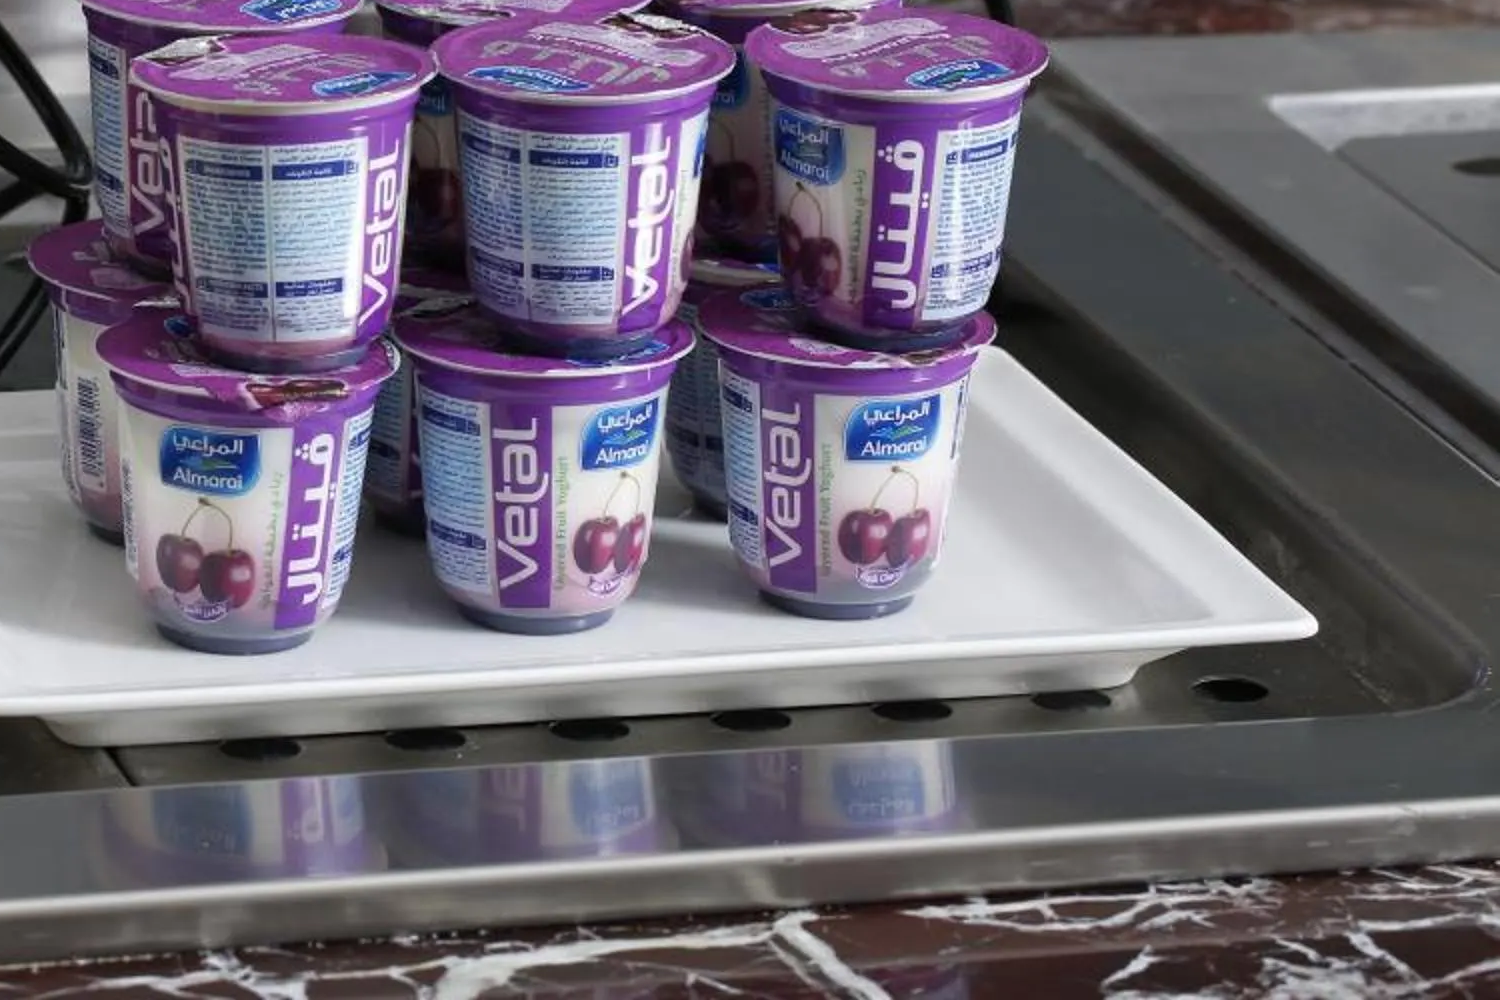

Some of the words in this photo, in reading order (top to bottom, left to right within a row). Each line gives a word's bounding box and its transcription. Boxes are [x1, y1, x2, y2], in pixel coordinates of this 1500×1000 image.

[129, 91, 167, 238] Veta
[780, 149, 831, 181] Almarai
[596, 403, 652, 433] المراعي
[863, 401, 930, 426] المراعي
[172, 432, 244, 457] المراعي
[595, 440, 649, 465] Almarai
[861, 436, 929, 457] Almarai
[173, 466, 244, 489] Almarai
